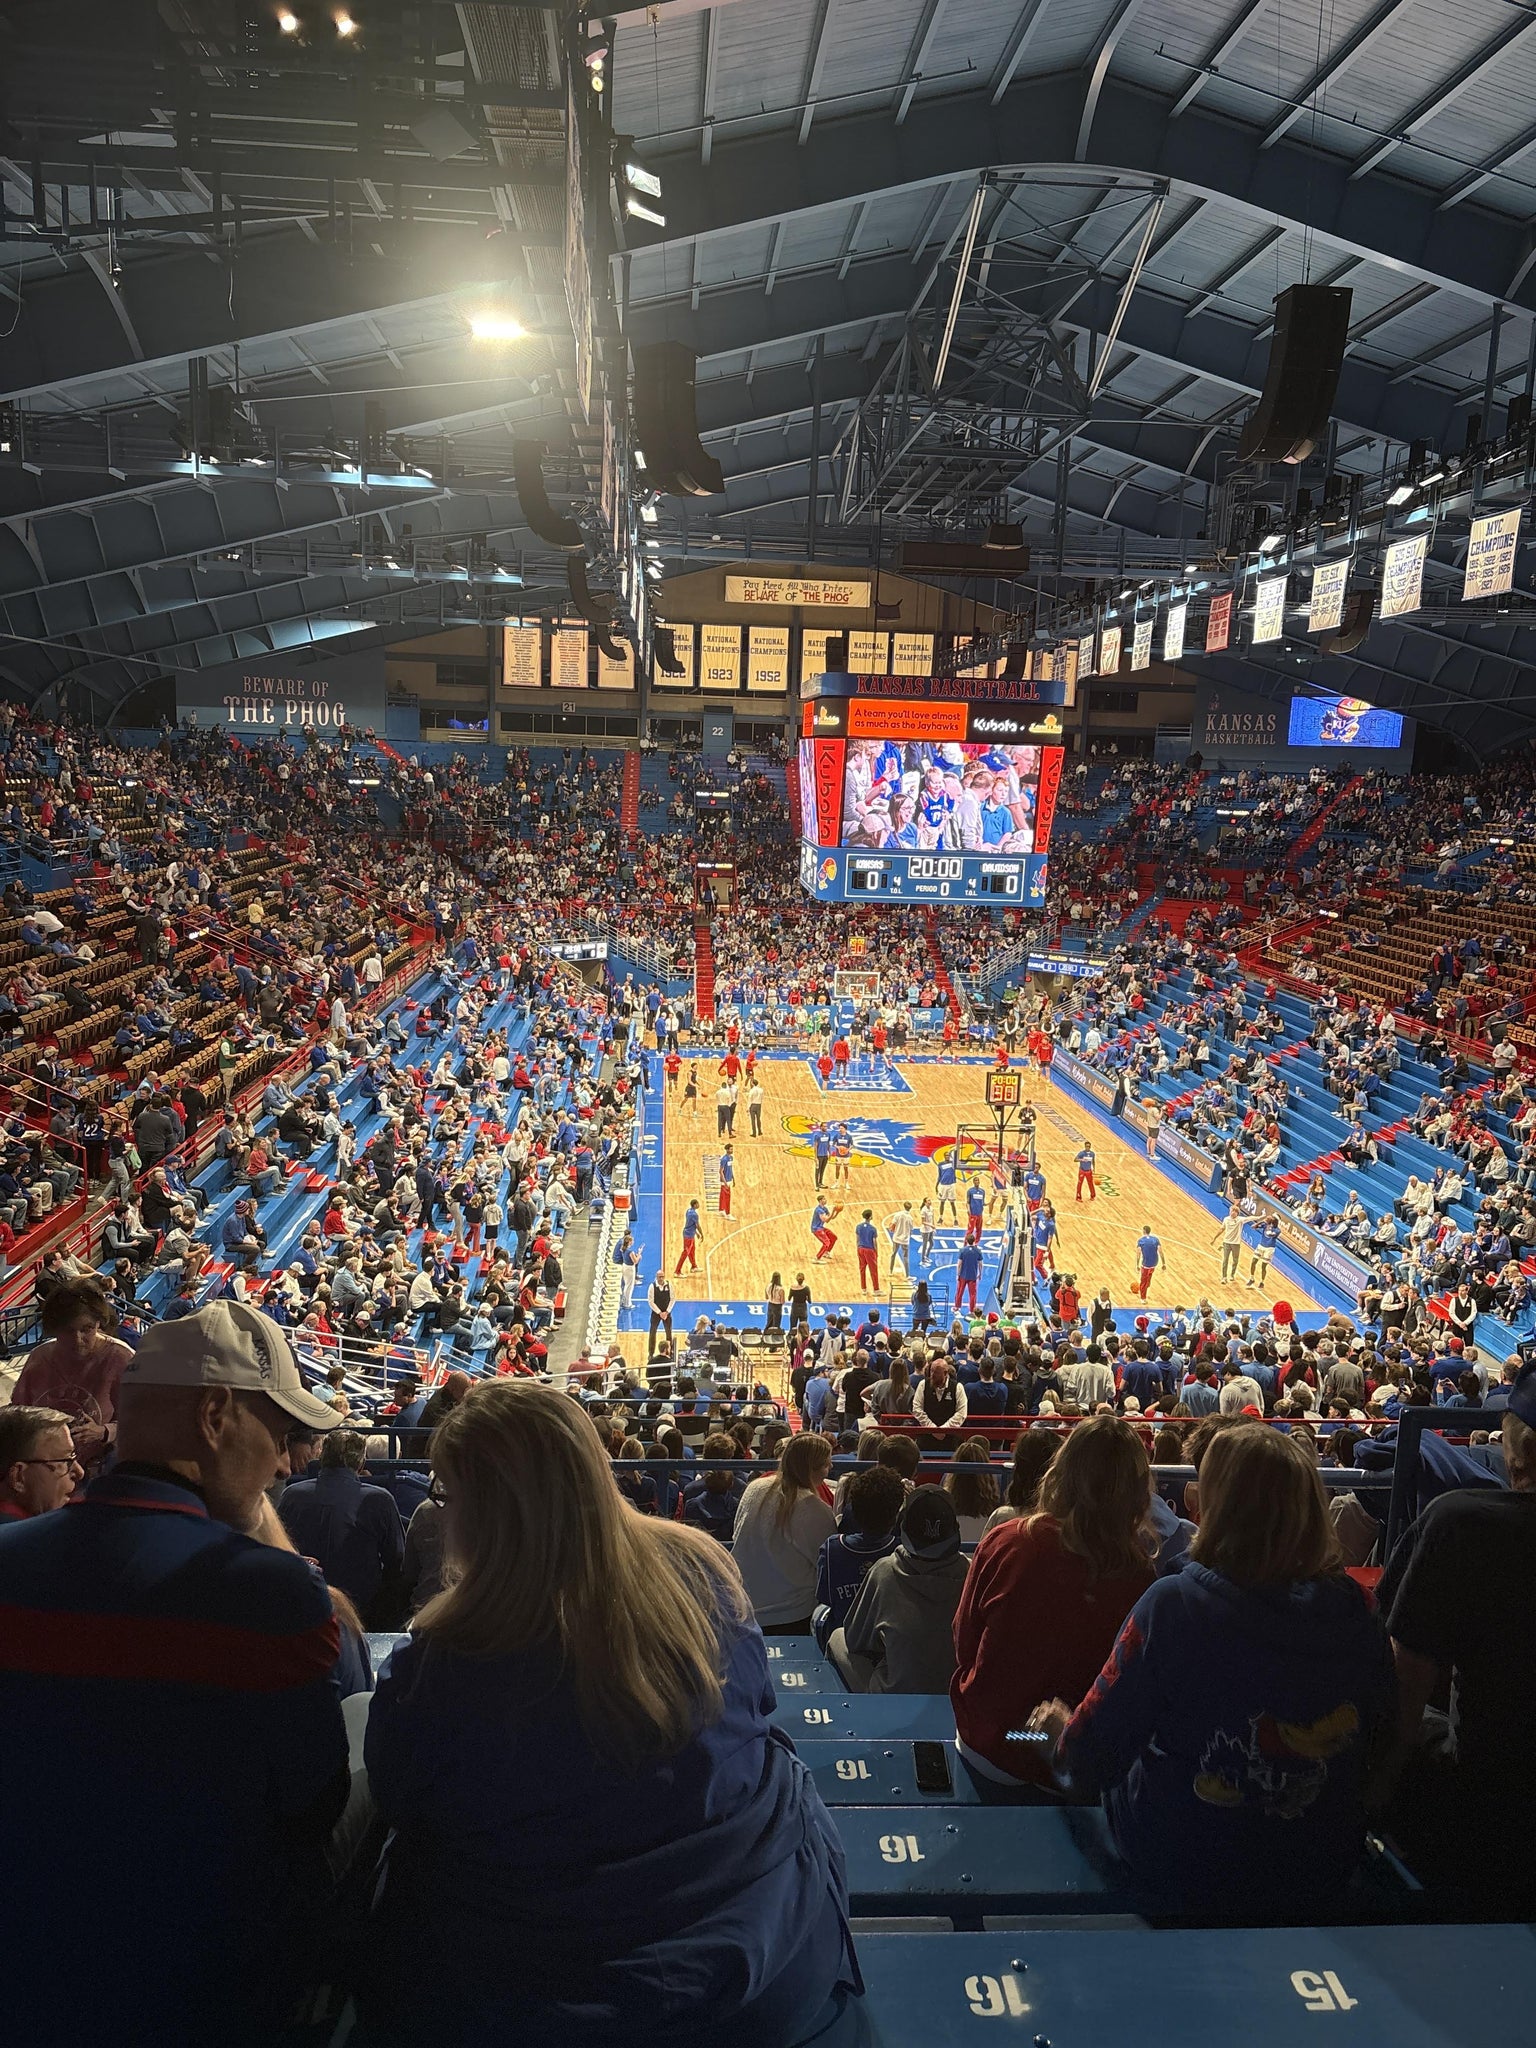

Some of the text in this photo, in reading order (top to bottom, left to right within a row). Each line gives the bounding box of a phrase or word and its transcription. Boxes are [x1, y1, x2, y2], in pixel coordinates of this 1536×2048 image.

[1470, 533, 1515, 556] CHAMPIONS
[744, 590, 779, 602] BEWARE
[785, 592, 799, 602] OF
[707, 635, 737, 644] NATIONAL
[754, 638, 784, 646] NATIONAL
[854, 642, 884, 650] NATIONAL
[898, 643, 929, 651] NATIONAL
[703, 645, 740, 654] CHAMPIONS
[750, 647, 787, 656] CHAMPIONS
[850, 651, 887, 660] CHAMPIONS
[895, 653, 932, 662] CHAMPIONS
[708, 668, 733, 680] 1923
[755, 671, 781, 682] 1952
[243, 676, 329, 698] BEWARE OF
[856, 675, 1040, 700] KANSAS BASKETBALL
[223, 696, 346, 727] THE PHOG
[564, 703, 575, 711] 21
[855, 708, 961, 722] A team you'll love almost
[1206, 713, 1276, 731] KANSAS
[712, 727, 724, 736] 22
[855, 719, 959, 734] as much as the Jayhawks
[974, 718, 1017, 733] Kubota
[1205, 733, 1276, 745] BASKETBALL
[819, 745, 836, 839] Kubota
[1037, 753, 1062, 850] Kubota
[856, 857, 1019, 878] KANSAS 20:00 DAVIDSON
[867, 871, 1018, 894] 0 4 4 0
[916, 884, 938, 893] PERIOD
[941, 882, 950, 897] 0
[992, 1075, 1017, 1085] 20:00
[83, 1122, 99, 1138] 22
[254, 1339, 273, 1380] KANSAS
[781, 1673, 807, 1687] 16
[803, 1708, 834, 1724] 16
[835, 1760, 872, 1780] 16
[878, 1835, 926, 1863] 16
[964, 1974, 1031, 2017] 16
[1290, 1970, 1360, 2011] 15
